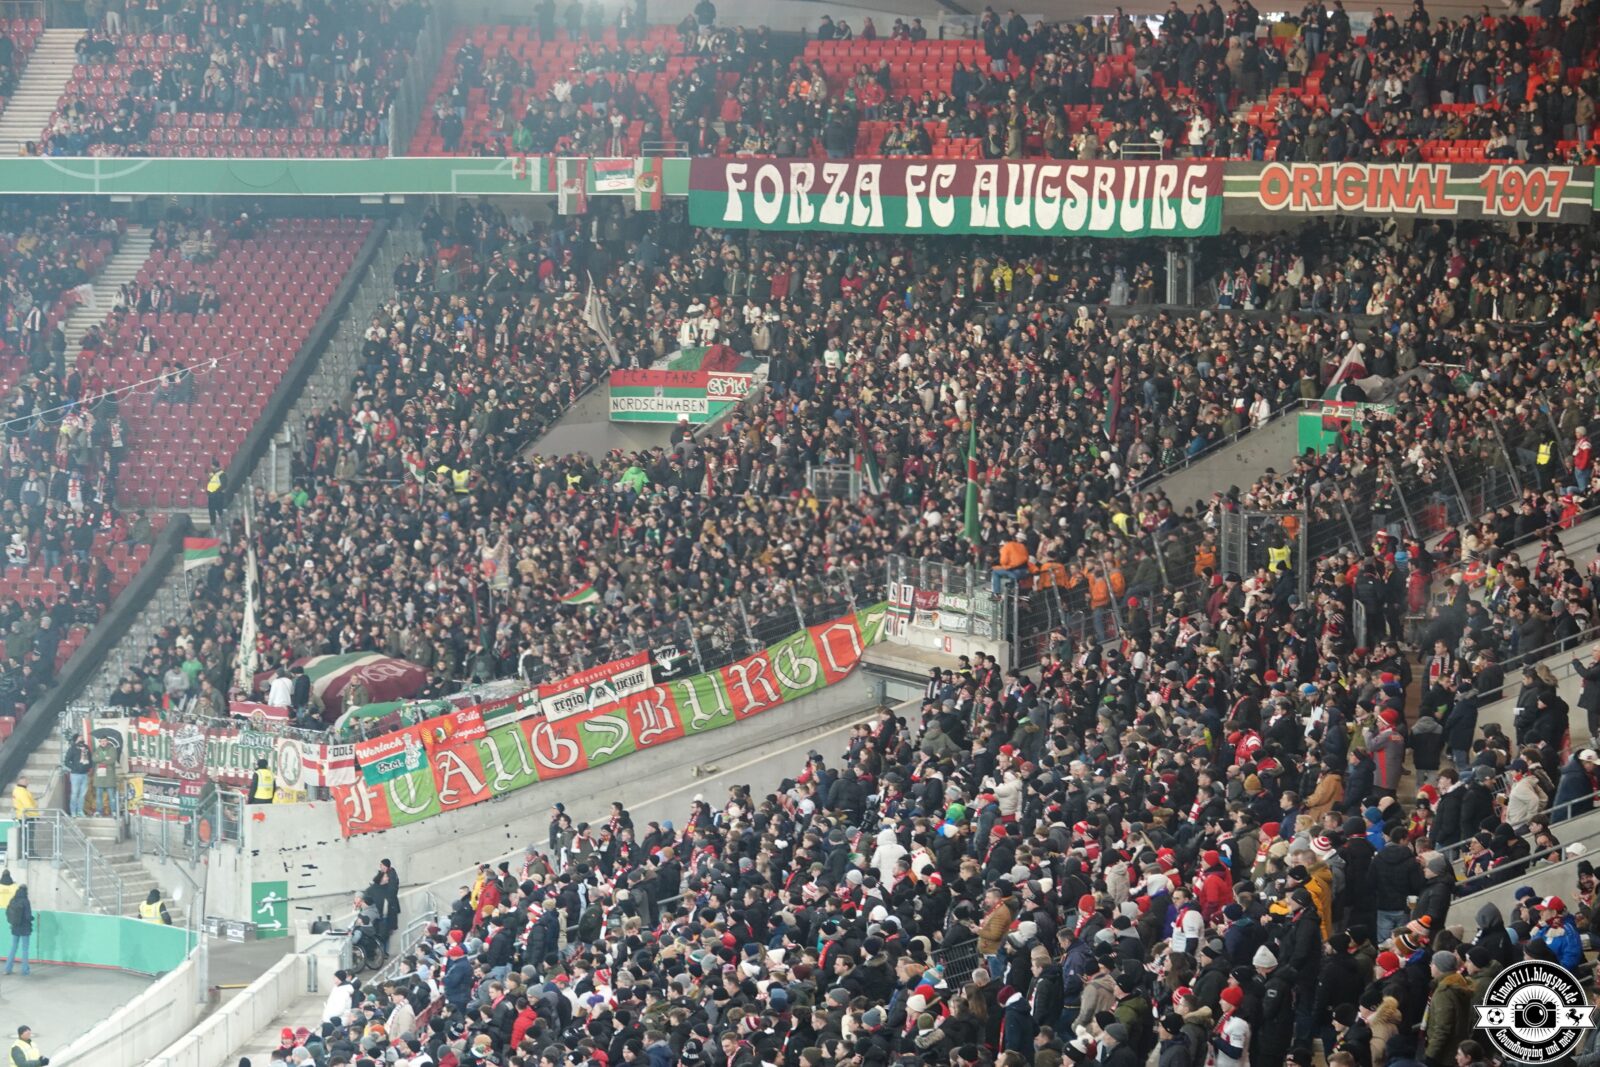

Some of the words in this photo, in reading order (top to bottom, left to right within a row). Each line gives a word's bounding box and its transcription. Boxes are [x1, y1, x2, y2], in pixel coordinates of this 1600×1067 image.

[722, 162, 885, 228] FORZA
[904, 163, 956, 229] FC
[969, 163, 1208, 232] AUGSBURG
[1259, 161, 1459, 215] ORIGINAL
[1479, 164, 1574, 218] 1907
[622, 371, 649, 384] FCA
[663, 371, 699, 384] FANS
[612, 398, 707, 412] NORDSCHWABEN
[552, 692, 585, 714] regio
[127, 731, 173, 761] LEGIO
